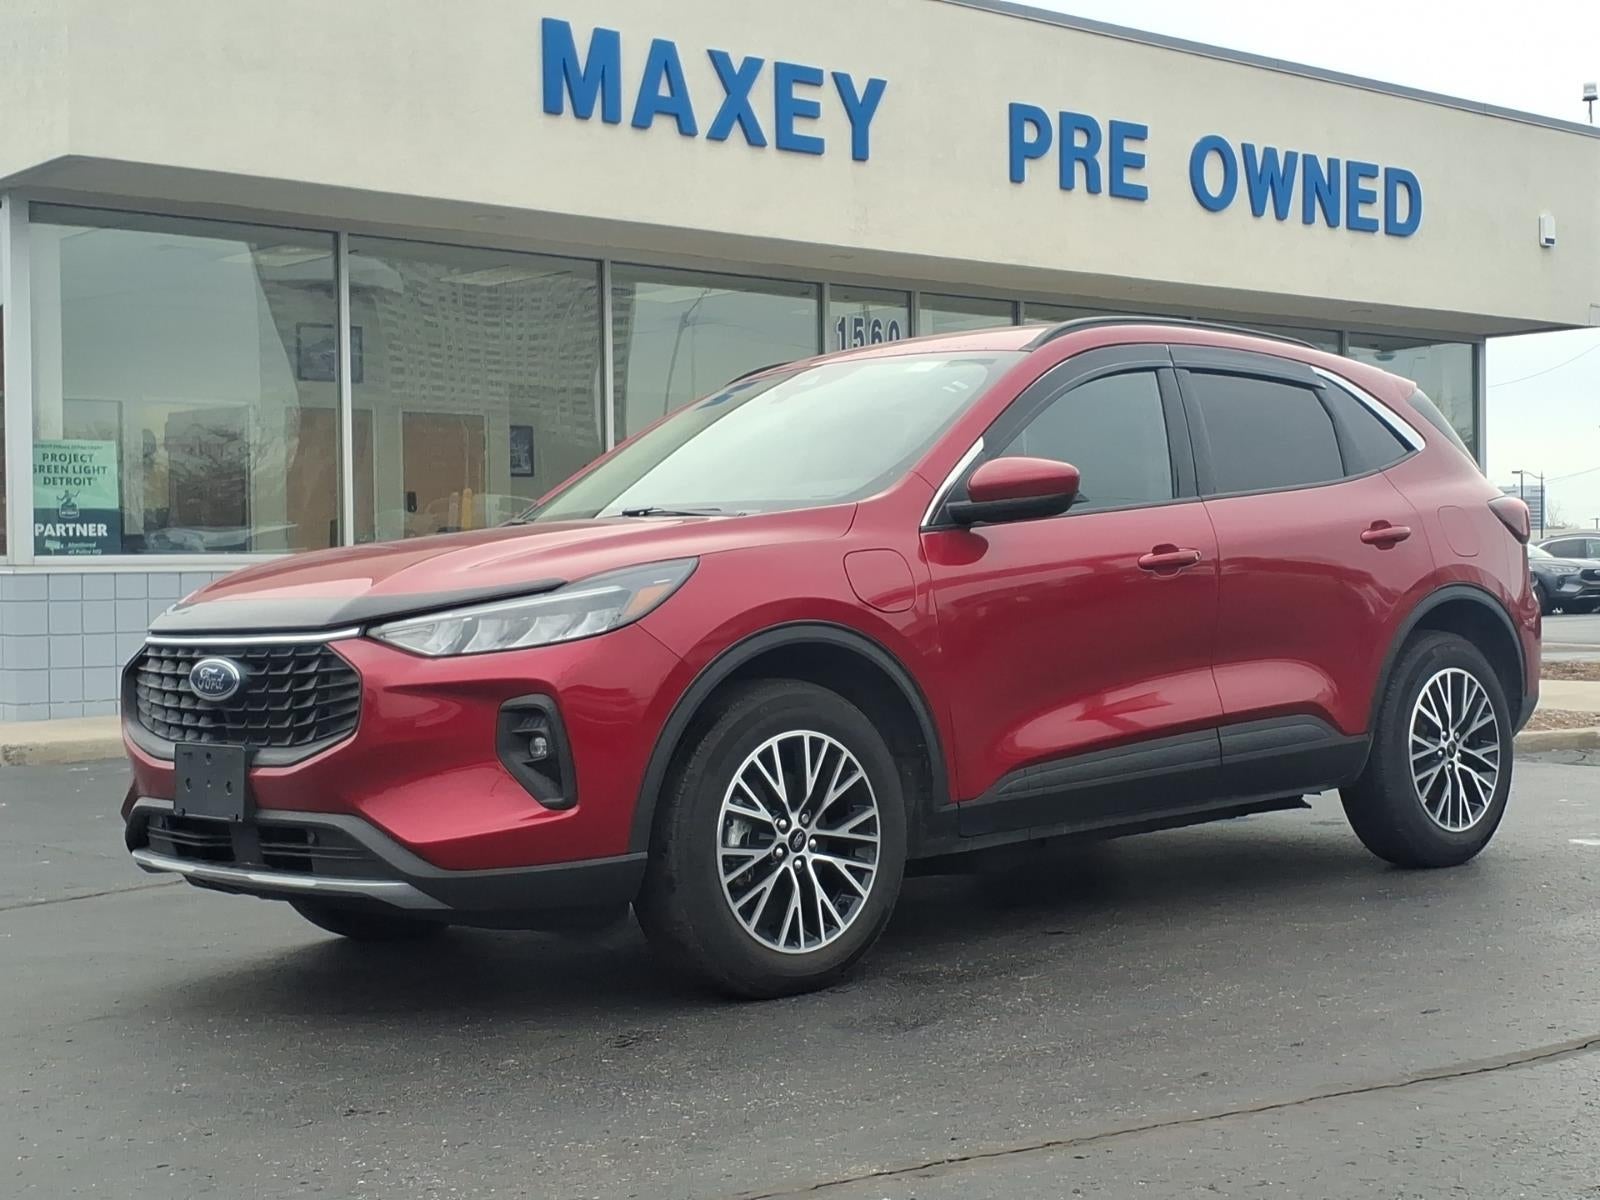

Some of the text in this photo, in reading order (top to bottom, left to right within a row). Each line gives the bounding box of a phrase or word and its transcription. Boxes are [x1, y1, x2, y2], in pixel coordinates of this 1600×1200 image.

[541, 16, 1423, 238] MAXEY PRE OWNED
[836, 315, 902, 352] 1560
[42, 452, 94, 464] PROJECT
[72, 465, 108, 475] LIGHT
[43, 476, 93, 486] DETROIT
[34, 523, 108, 537] PARTNER
